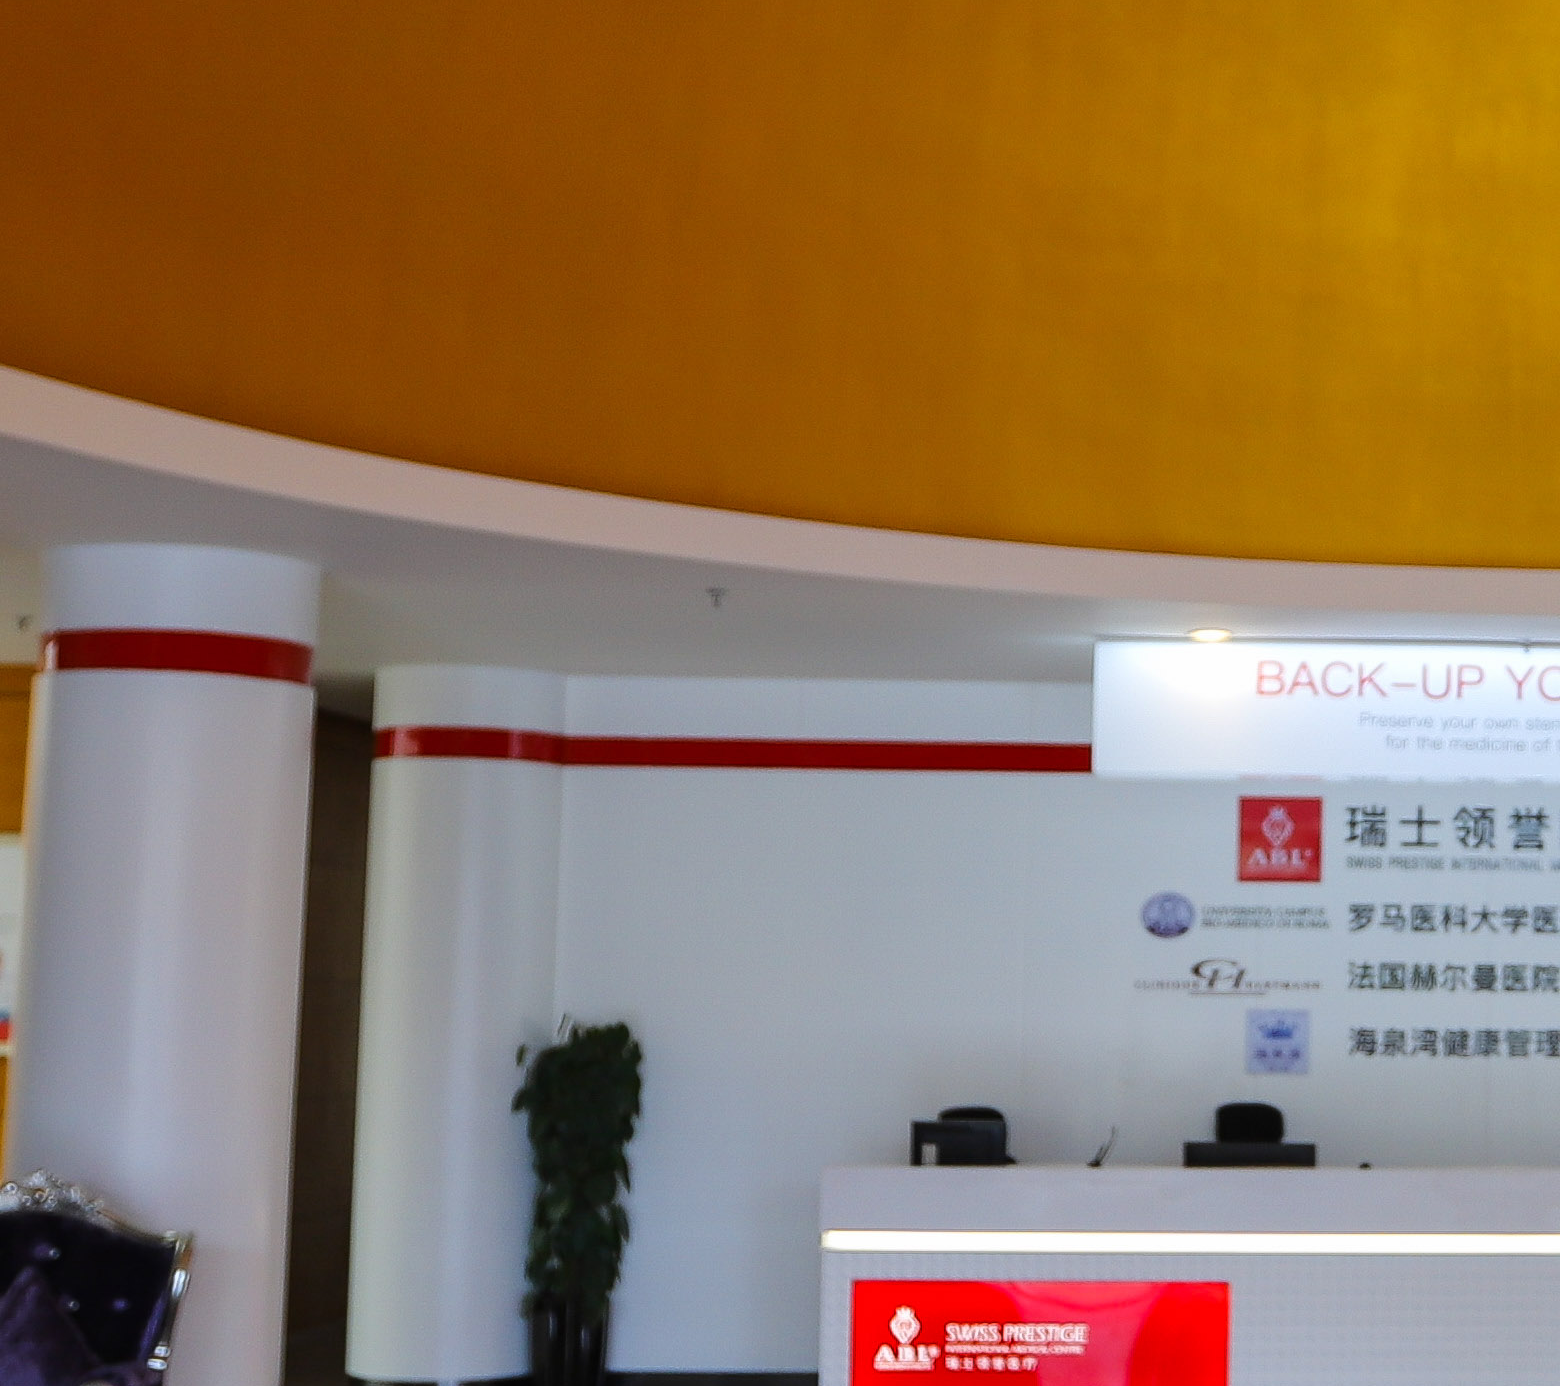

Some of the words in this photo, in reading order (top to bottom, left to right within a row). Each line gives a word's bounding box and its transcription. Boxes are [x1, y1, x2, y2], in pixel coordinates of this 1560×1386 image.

[1255, 660, 1484, 701] BACK-UP
[1358, 712, 1435, 729] Preserve
[1441, 717, 1477, 732] your
[1484, 719, 1519, 731] own
[1385, 734, 1410, 750] for
[1416, 735, 1443, 751] the
[1449, 736, 1526, 753] medicine
[1531, 736, 1552, 753] of
[1346, 856, 1382, 871] SWISS
[1388, 856, 1445, 872] PRESTIGE
[1347, 961, 1560, 994] 法国赫尔曼医院
[945, 1323, 1001, 1343] SWISS
[1003, 1323, 1089, 1343] PRESTIGE
